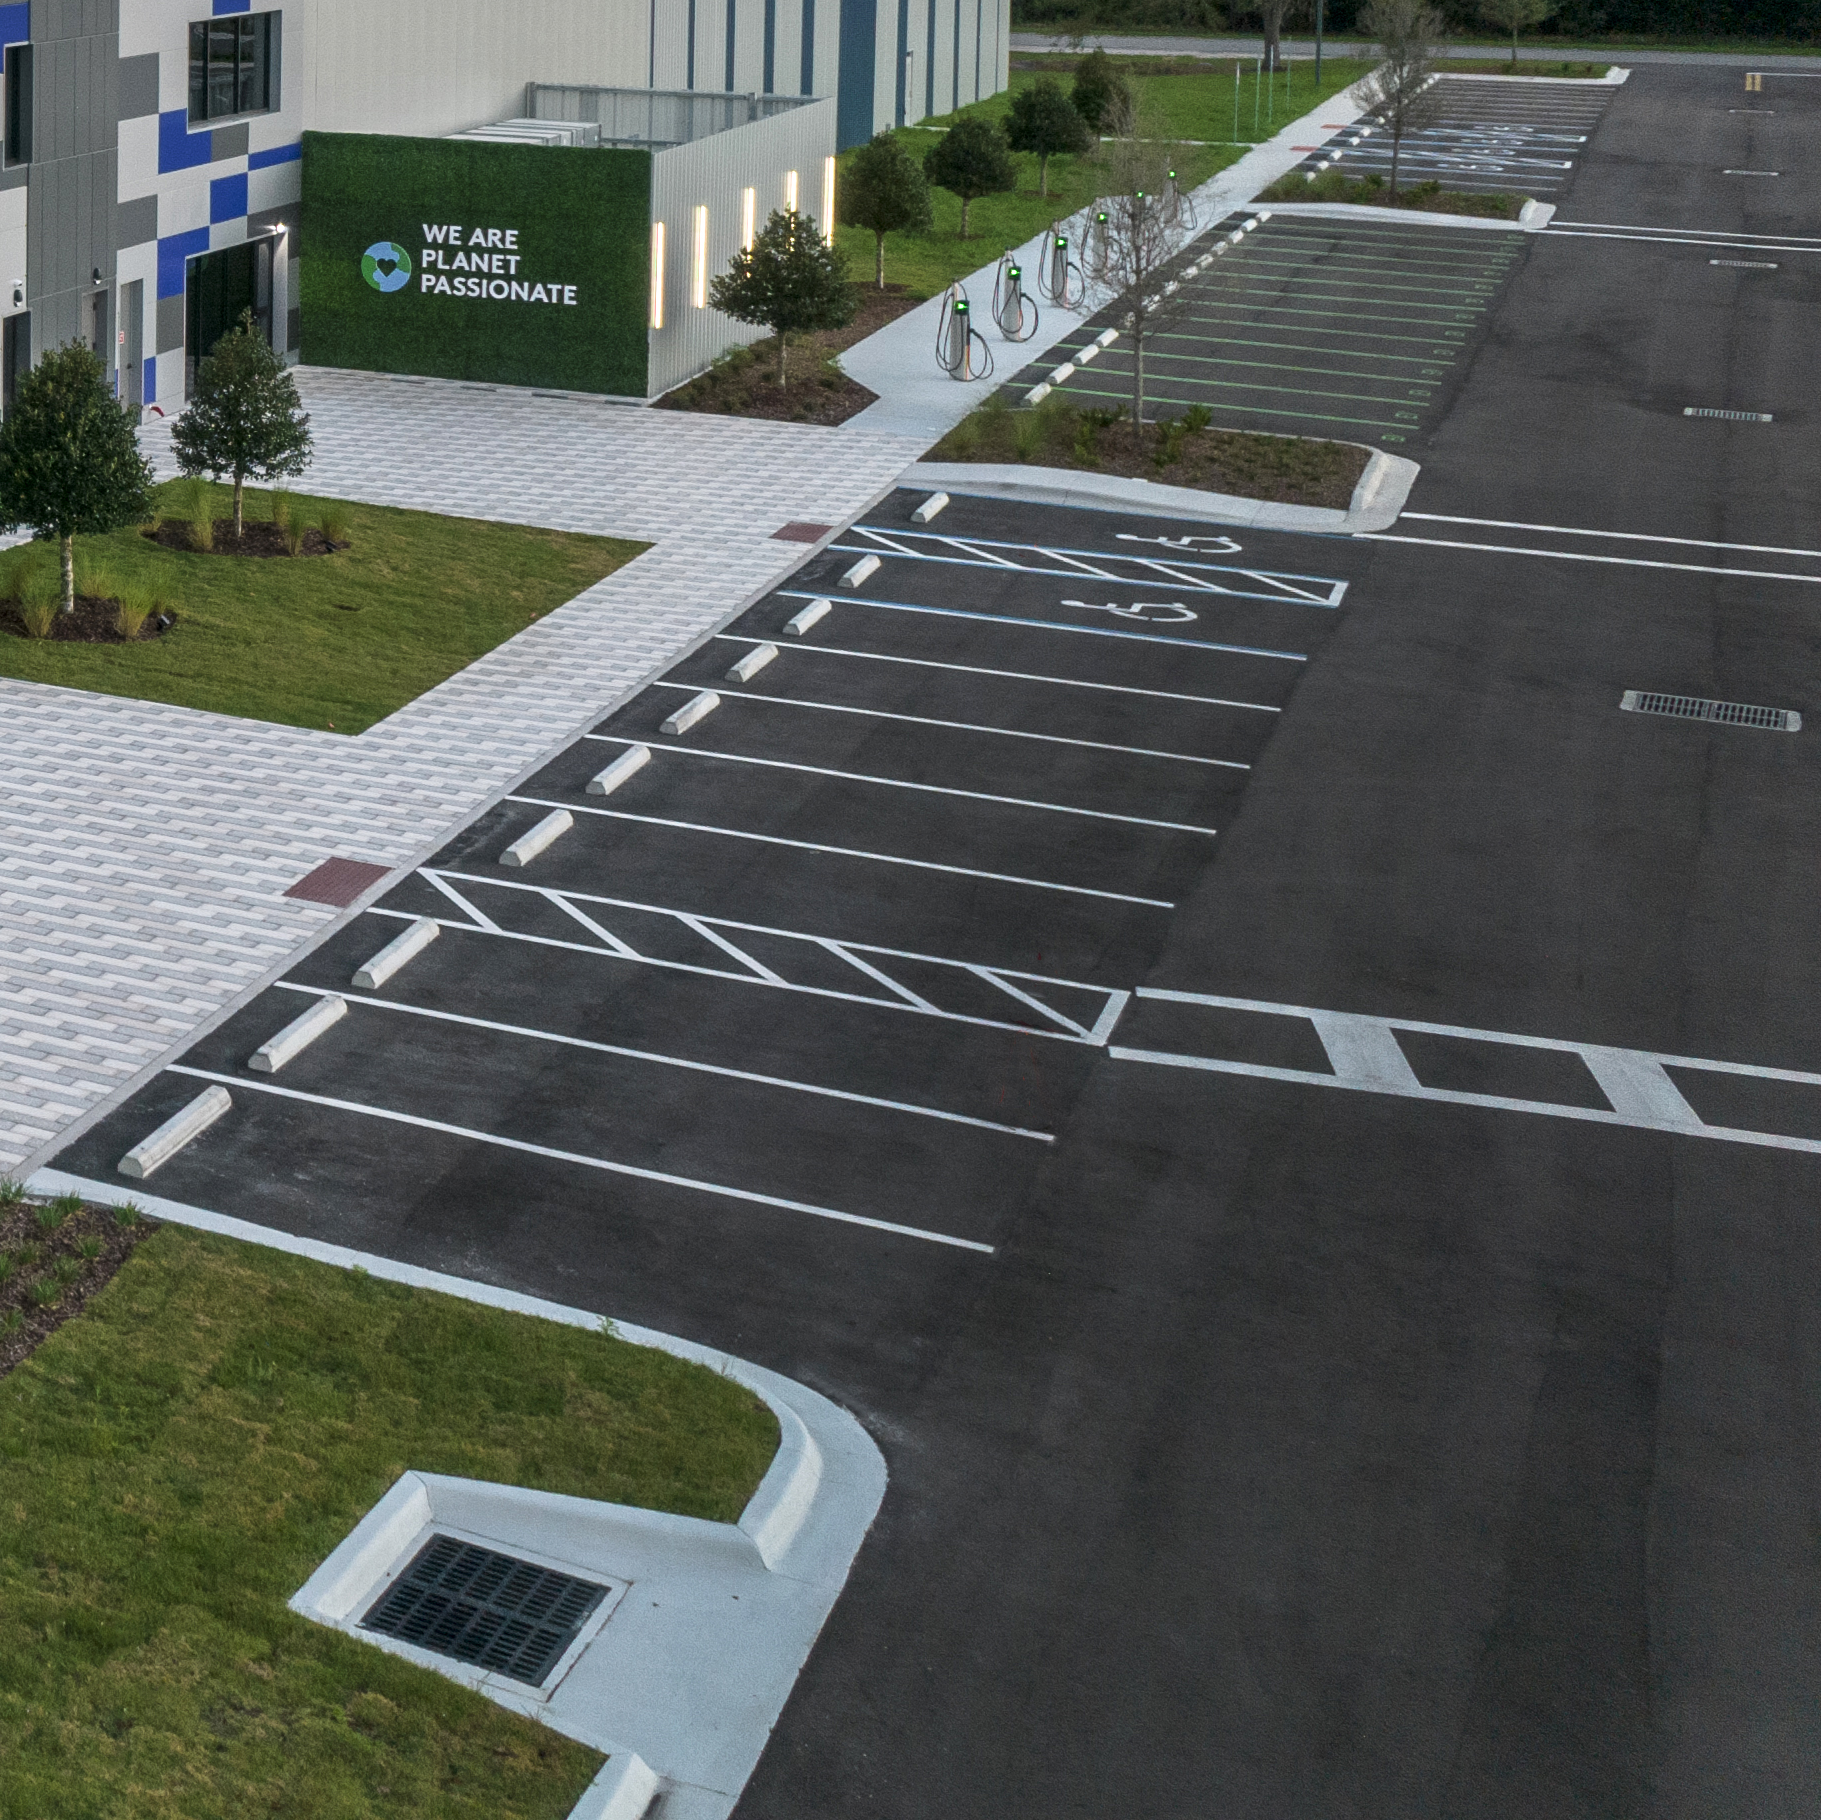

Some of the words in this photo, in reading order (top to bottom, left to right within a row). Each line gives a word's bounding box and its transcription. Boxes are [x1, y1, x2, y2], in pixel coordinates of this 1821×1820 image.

[422, 223, 463, 246] WE
[467, 227, 519, 250] ARE
[421, 248, 521, 275] PLANET
[420, 273, 578, 306] PASSIONATE
